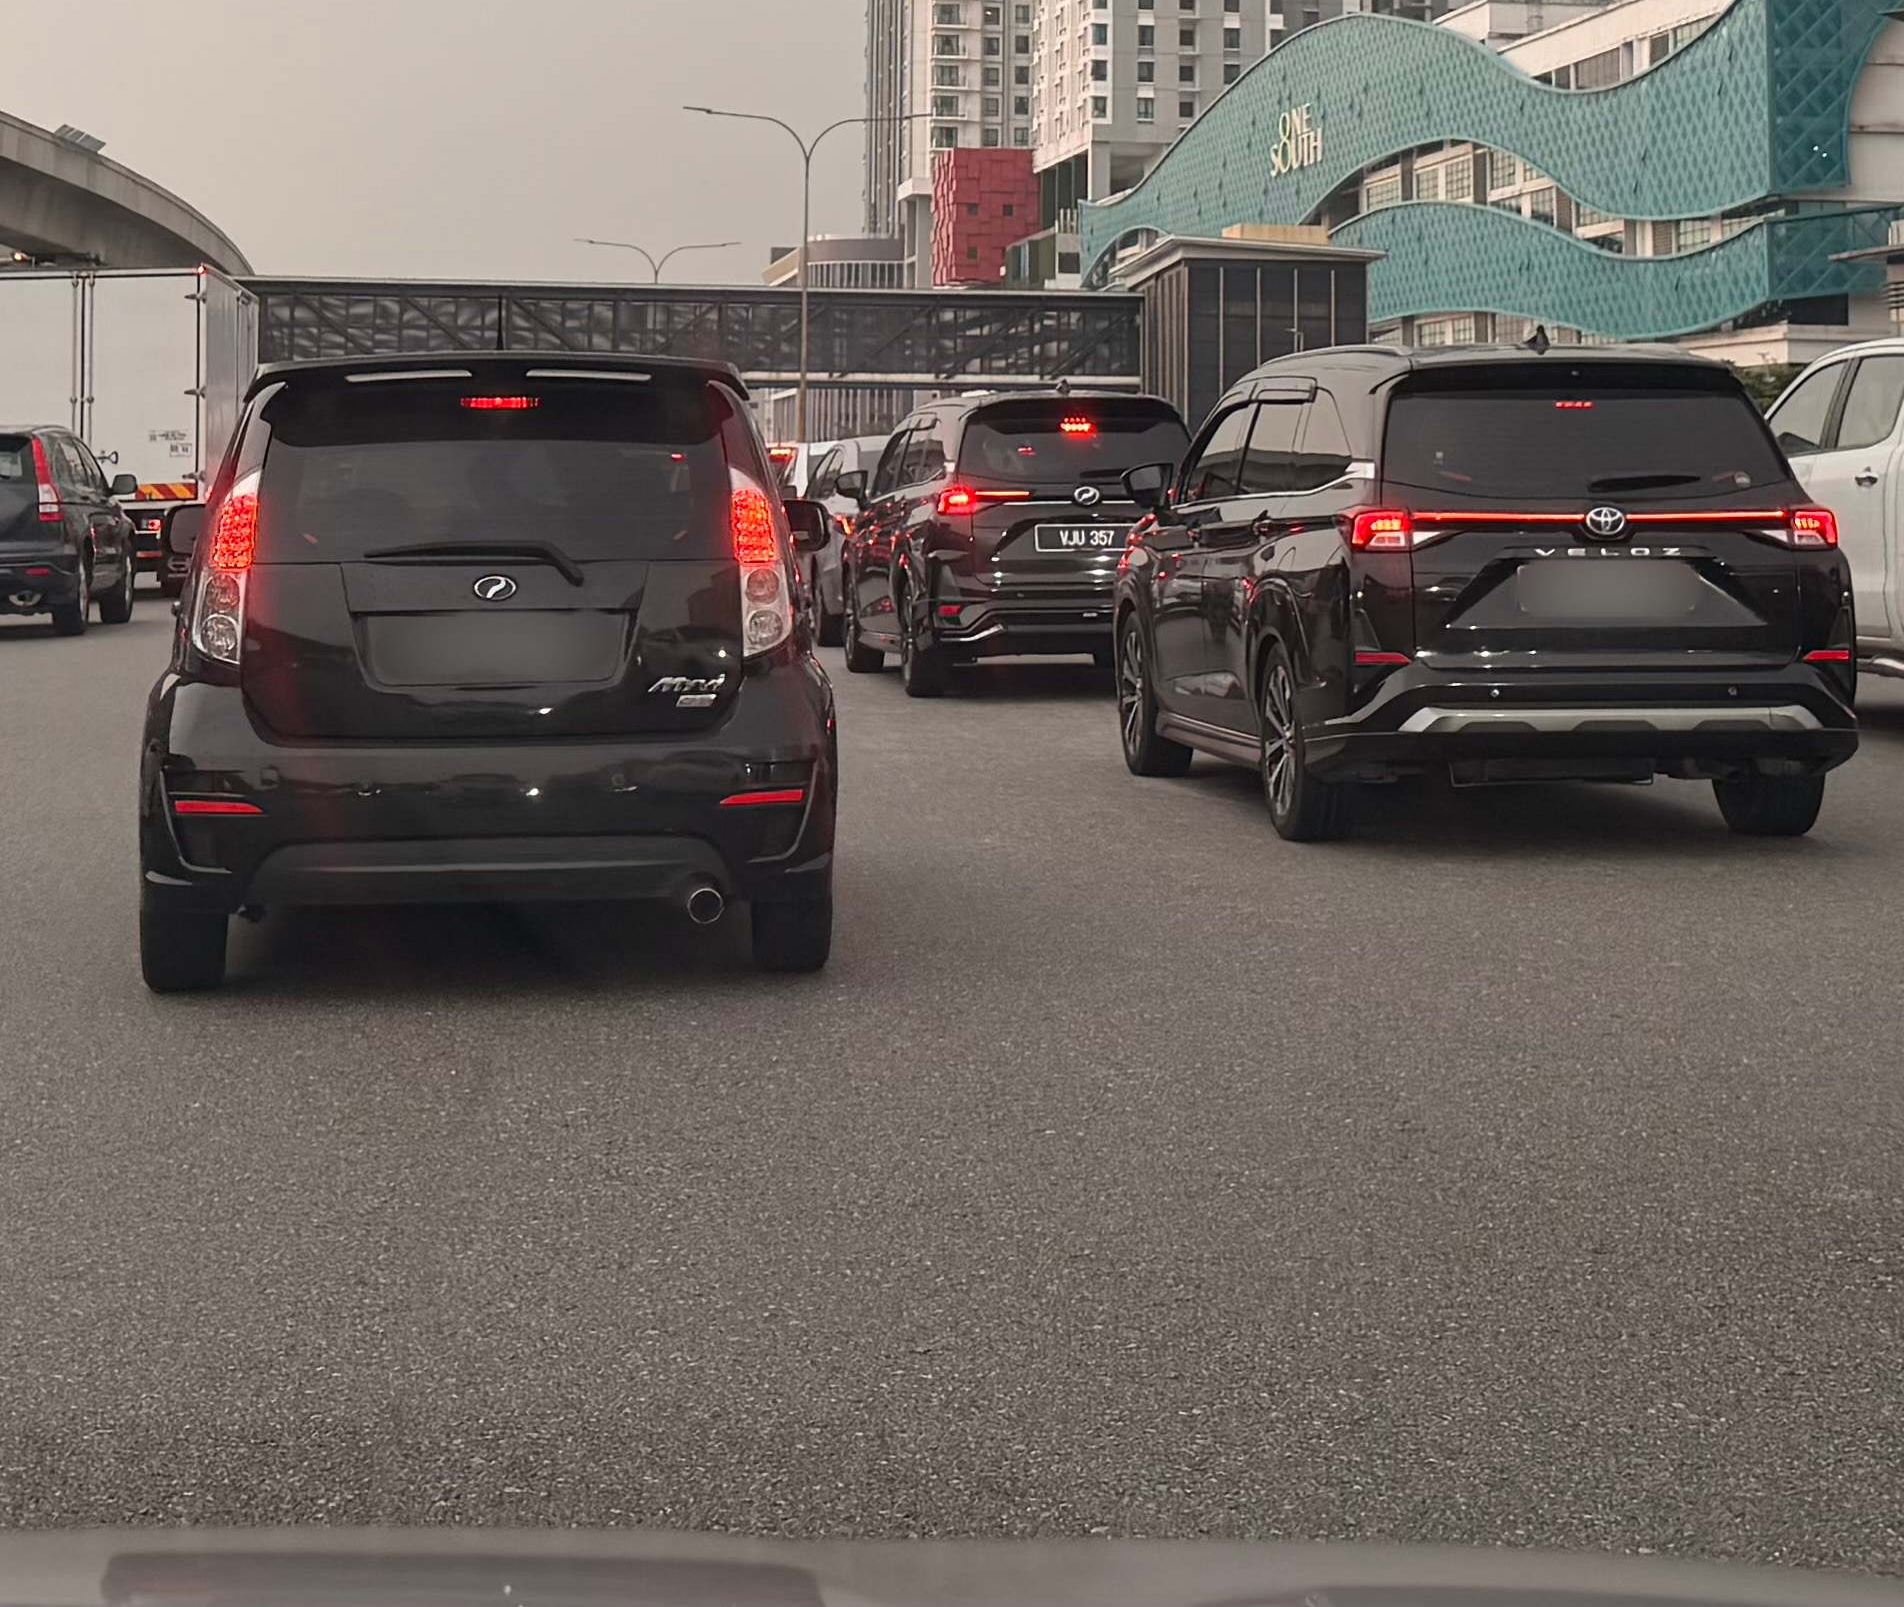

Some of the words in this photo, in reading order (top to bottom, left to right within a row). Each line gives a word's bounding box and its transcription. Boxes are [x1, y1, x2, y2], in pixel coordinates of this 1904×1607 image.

[1279, 102, 1312, 139] ONE
[1270, 126, 1323, 177] SOUTH
[1059, 530, 1085, 546] VJU
[1089, 530, 1114, 546] 357
[1534, 547, 1681, 557] VELOZ
